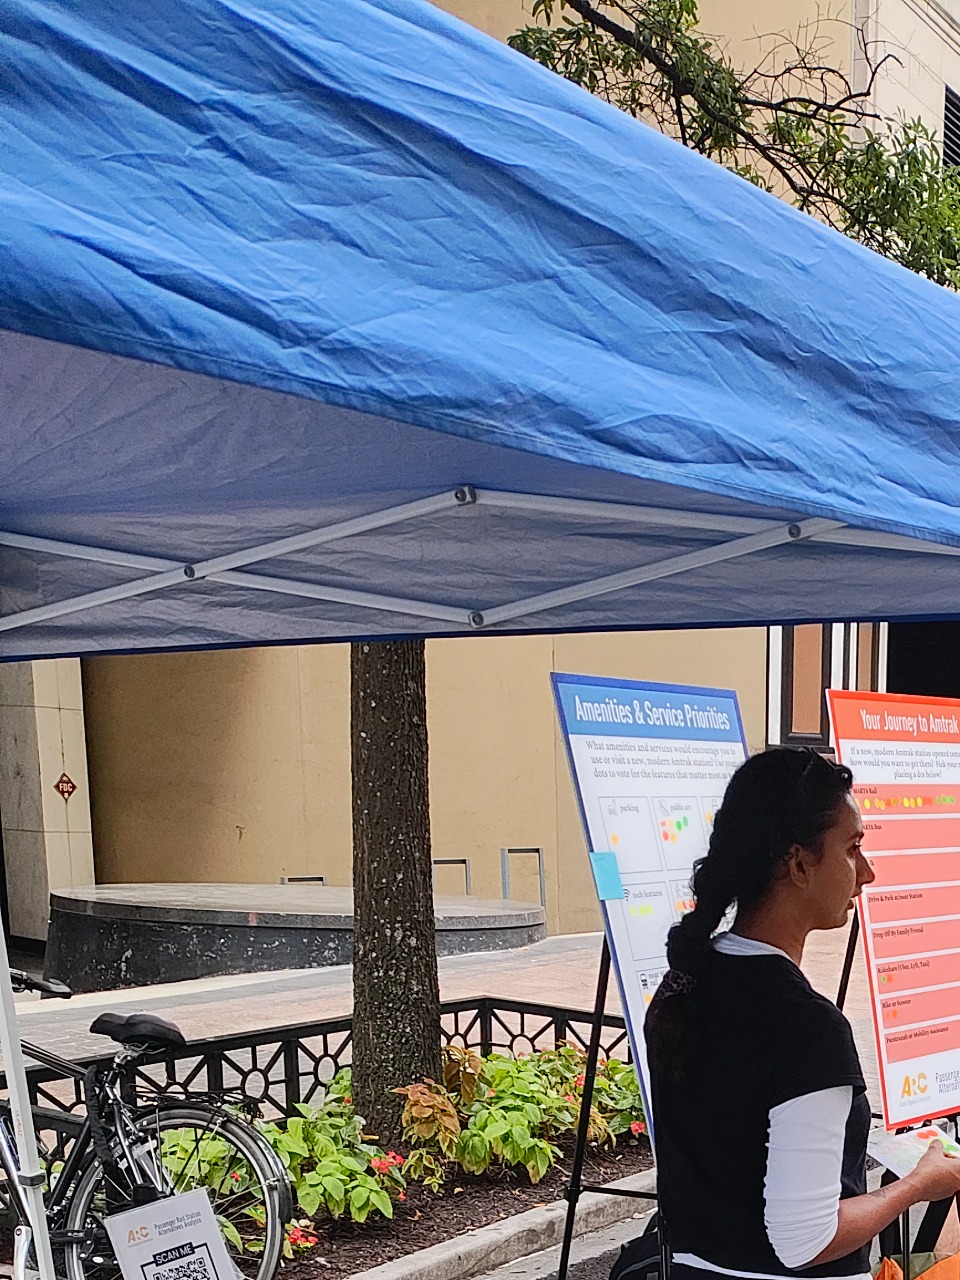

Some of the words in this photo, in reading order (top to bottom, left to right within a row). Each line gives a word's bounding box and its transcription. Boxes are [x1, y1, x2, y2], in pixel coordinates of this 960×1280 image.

[575, 695, 633, 724] Amenities
[633, 700, 645, 725] &
[644, 701, 685, 727] Service
[684, 704, 730, 730] Priorities
[860, 708, 881, 730] Your
[884, 710, 917, 736] Journey
[918, 714, 928, 733] to
[929, 713, 959, 734] Amtrak
[585, 740, 605, 750] What
[606, 741, 636, 752] amenities
[637, 742, 649, 752] and
[650, 743, 672, 753] services
[673, 744, 691, 754] would
[692, 747, 719, 757] encourage
[720, 748, 730, 757] you
[851, 746, 856, 755] If
[861, 749, 874, 757] new,
[874, 747, 894, 756] modern
[896, 748, 914, 756] Amtrak
[914, 748, 931, 757] station
[932, 749, 949, 759] opened
[591, 756, 603, 764] use
[611, 754, 627, 765] visit
[631, 758, 647, 767] new,
[647, 756, 670, 765] modern
[671, 757, 692, 766] Amtrak
[850, 757, 862, 766] how
[863, 758, 880, 767] would
[881, 761, 891, 769] you
[911, 761, 919, 769] get
[947, 762, 957, 770] your
[594, 767, 608, 778] dots
[608, 770, 616, 778] to
[616, 770, 630, 778] vote
[631, 768, 640, 778] for
[640, 768, 651, 778] the
[652, 769, 676, 779] features
[676, 769, 688, 779] that
[689, 771, 707, 779] matter
[894, 770, 912, 780] placing
[917, 770, 925, 778] dot
[925, 770, 942, 778] below!
[59, 782, 73, 791] FDC
[620, 803, 639, 813] parking
[633, 890, 644, 898] tech
[644, 890, 663, 898] features
[868, 895, 879, 903] Drive
[913, 1029, 930, 1038] Mobility
[154, 1219, 176, 1230] Passenger
[176, 1215, 185, 1223] Rail
[185, 1211, 202, 1220] Station
[158, 1223, 184, 1237] Alternatives
[184, 1217, 202, 1229] Analysis
[155, 1249, 180, 1264] SCAN
[180, 1245, 193, 1257] ME
